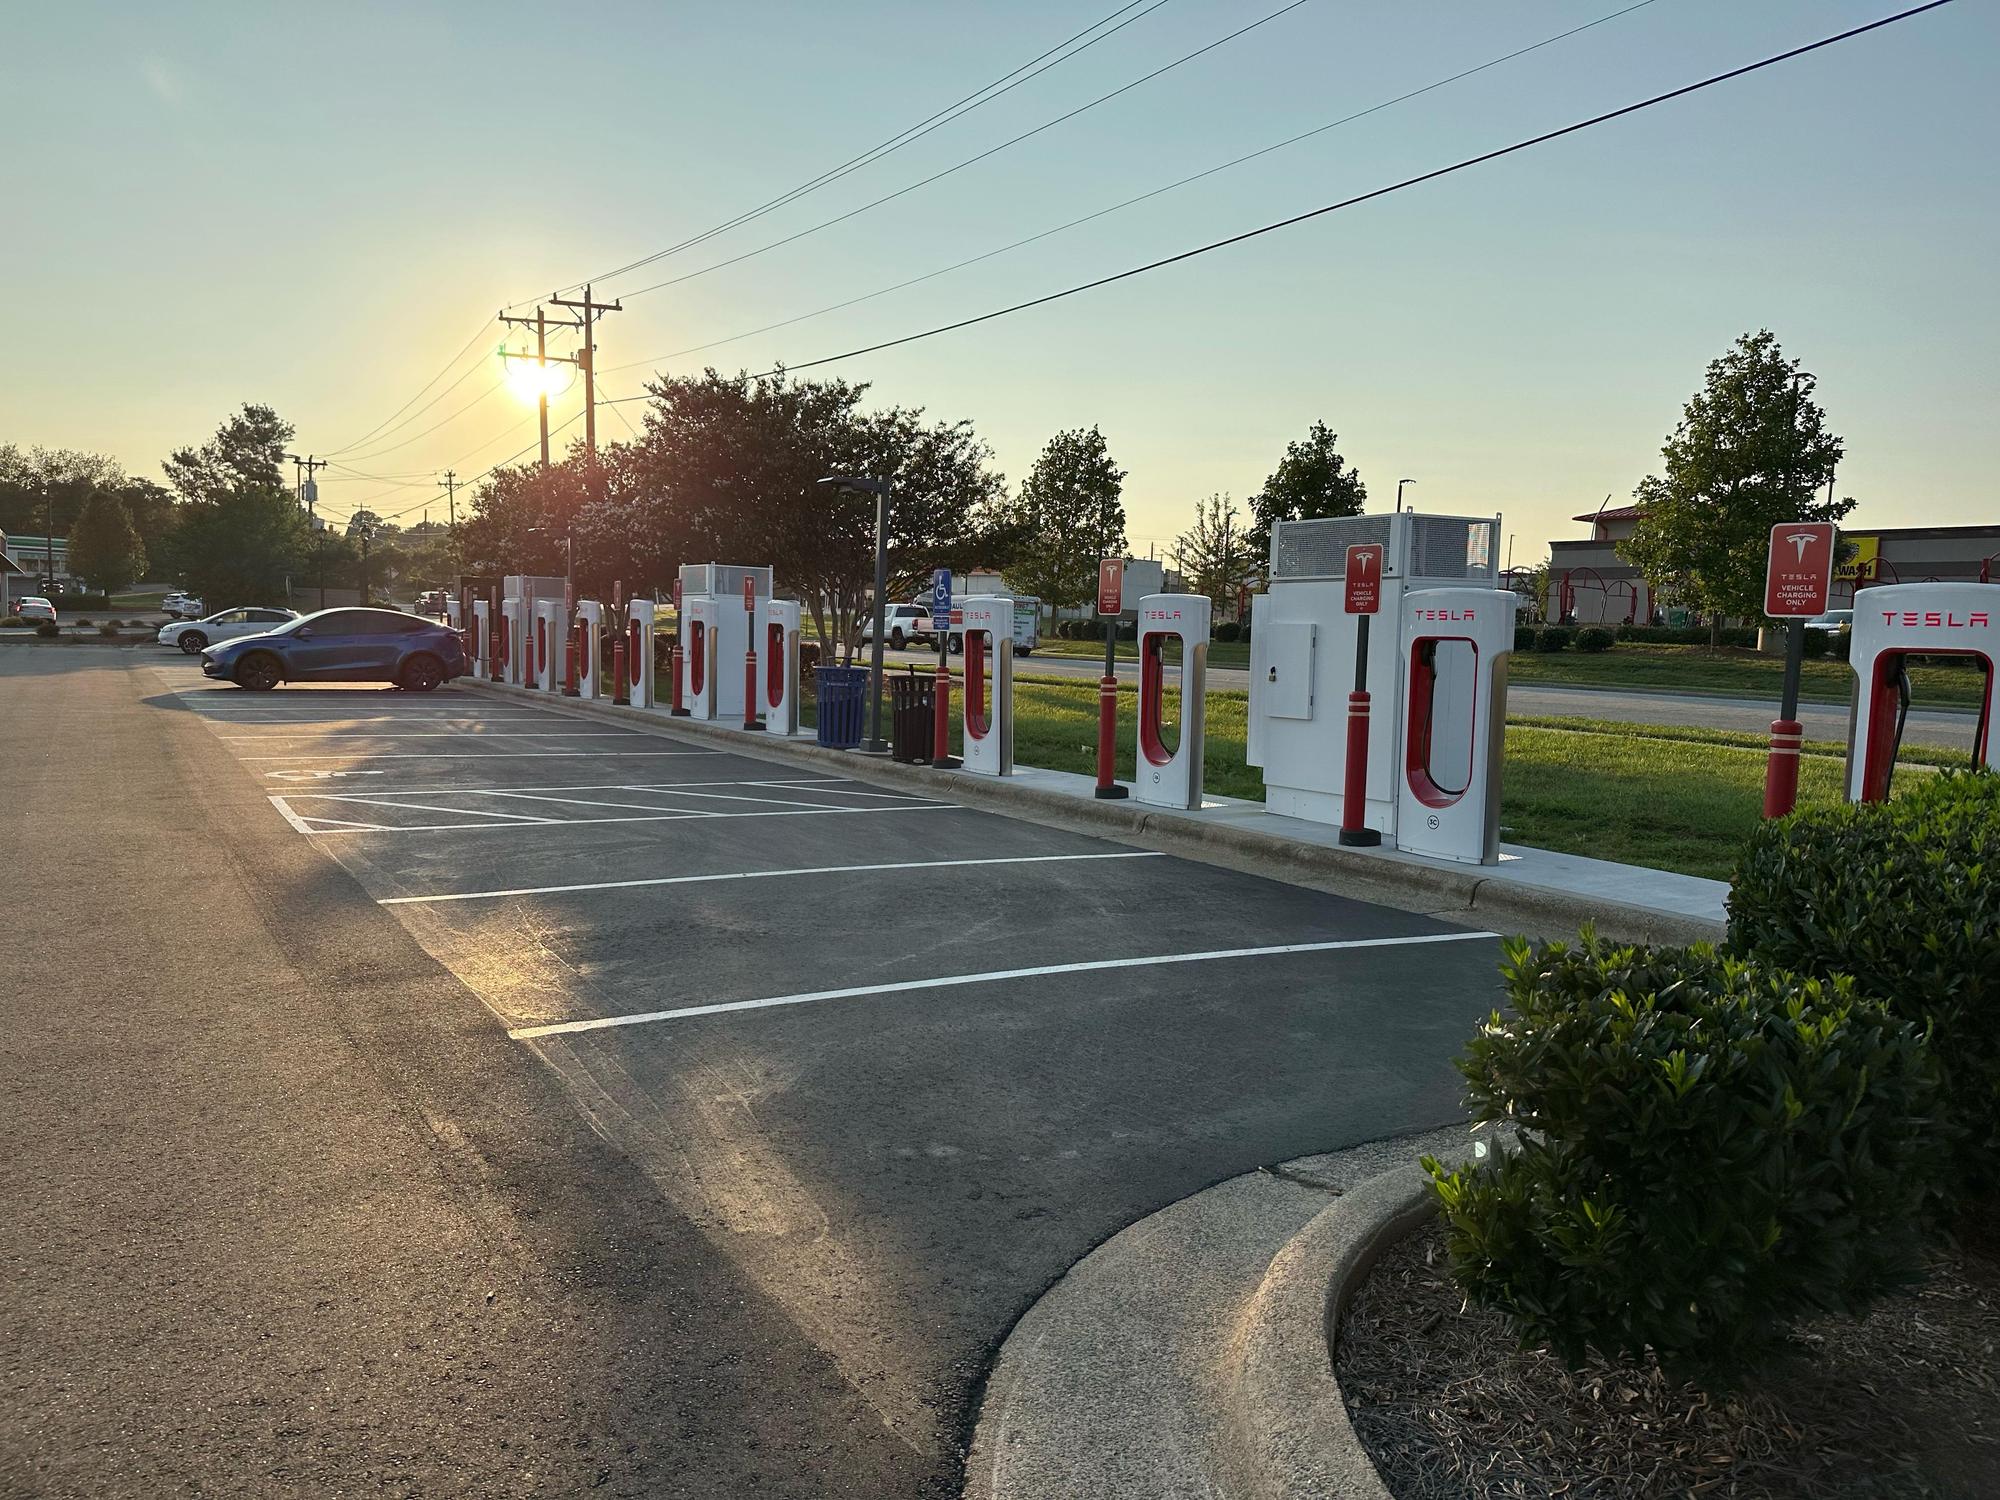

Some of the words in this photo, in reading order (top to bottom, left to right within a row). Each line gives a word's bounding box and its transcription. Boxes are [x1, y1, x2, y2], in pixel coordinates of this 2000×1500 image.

[966, 611, 991, 620] TESLA
[1144, 610, 1181, 620] TESLA
[1415, 609, 1475, 621] TESLA
[1881, 612, 1989, 628] TESLA
